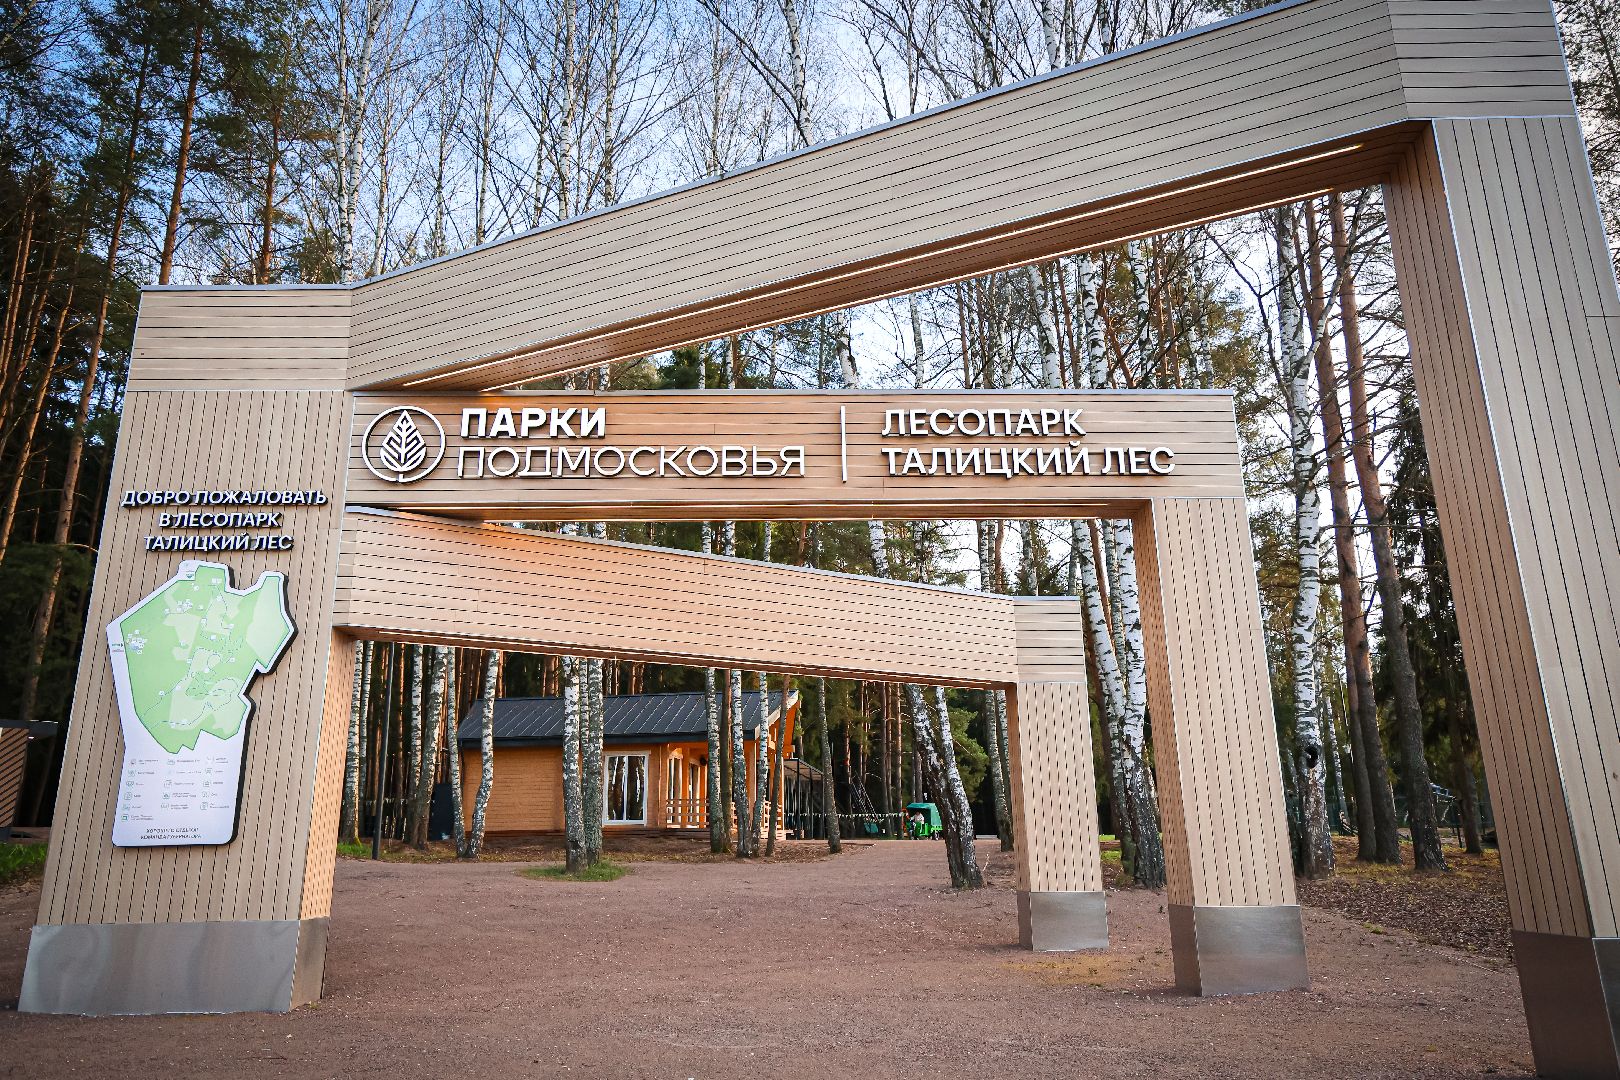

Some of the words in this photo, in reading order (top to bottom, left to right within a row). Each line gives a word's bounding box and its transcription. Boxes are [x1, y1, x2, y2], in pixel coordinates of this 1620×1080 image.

[460, 407, 607, 438] ПАРКИ
[881, 408, 1087, 436] ЛЕСОПАРК
[457, 445, 806, 477] ПОДМОСКОВЬЯ
[881, 441, 1091, 478] ТАЛИЦКИЙ
[1101, 446, 1176, 475] ЛЕС
[121, 490, 191, 507] ДОБРО
[194, 490, 328, 506] ПОЖАЛОВАТЬ
[159, 513, 171, 527] В
[174, 512, 282, 528] ЛЕСОПАРК
[144, 533, 250, 551] ТАЛИЦКИЙ
[253, 535, 294, 550] ЛЕС
